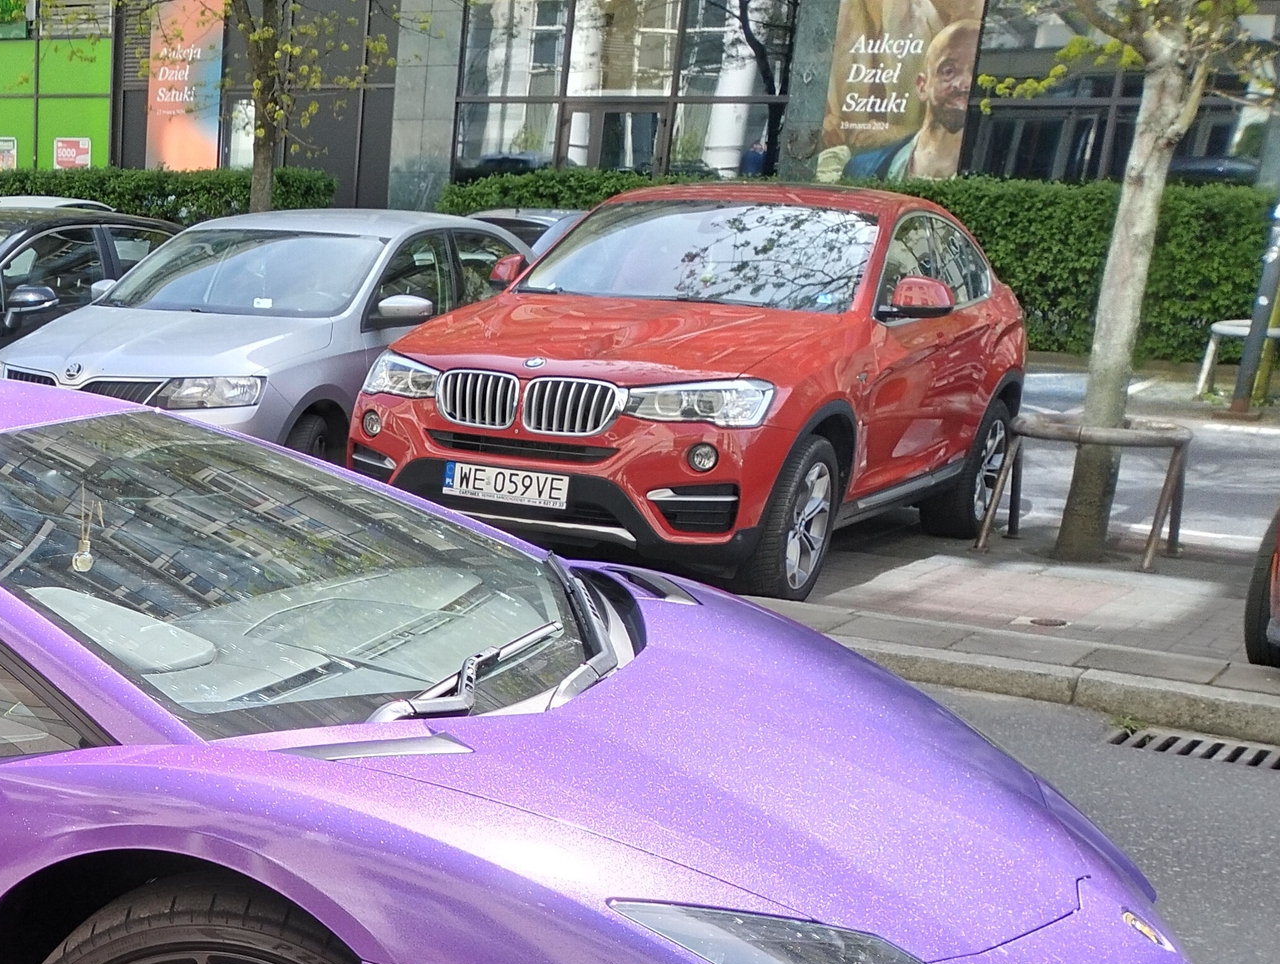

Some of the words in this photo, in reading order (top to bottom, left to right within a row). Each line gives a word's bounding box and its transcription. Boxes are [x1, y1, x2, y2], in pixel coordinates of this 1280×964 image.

[849, 33, 924, 58] Aukcja
[158, 65, 189, 81] Dzieł
[847, 62, 902, 83] Dzieł
[156, 86, 195, 102] Sztuki
[842, 92, 909, 113] Sztuki
[460, 466, 486, 490] WE
[493, 471, 564, 500] 059VE
